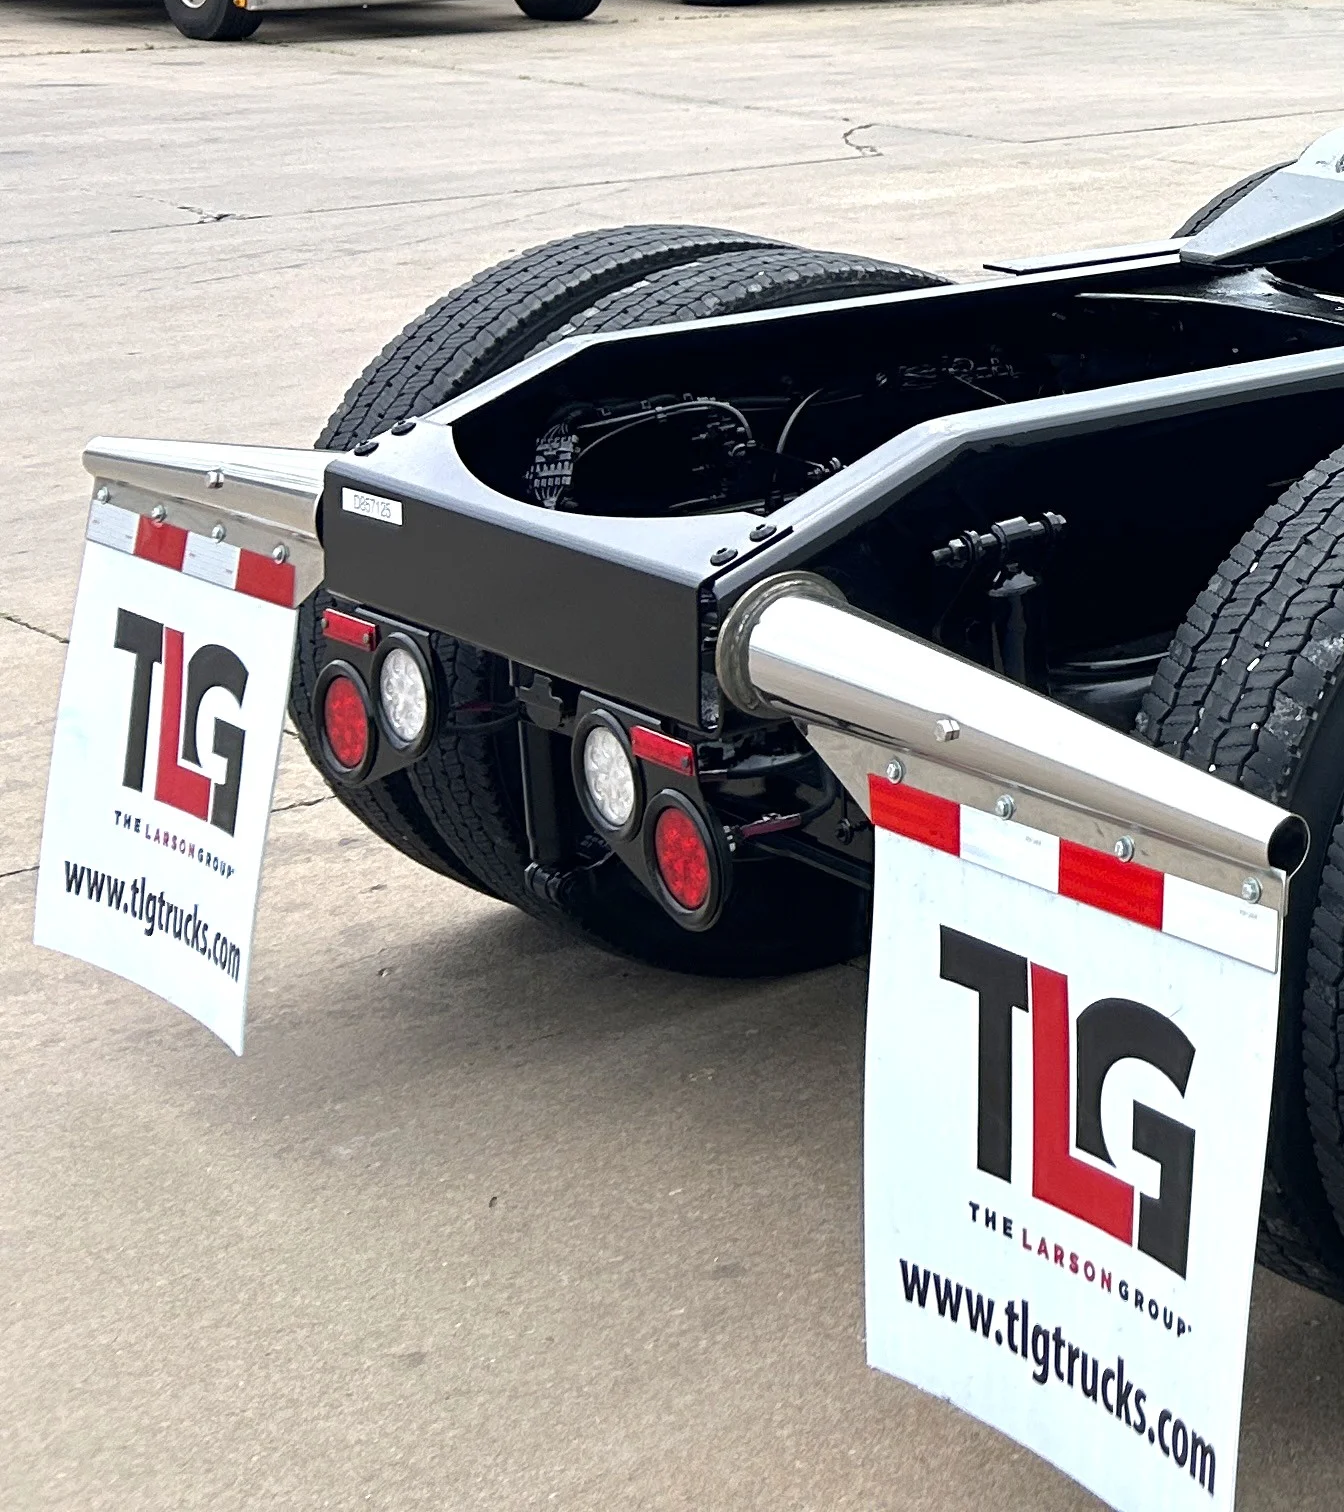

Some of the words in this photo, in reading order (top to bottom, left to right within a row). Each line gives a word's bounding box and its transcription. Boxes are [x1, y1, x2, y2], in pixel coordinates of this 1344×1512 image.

[113, 606, 249, 838] TLG
[64, 859, 241, 984] www.tlgtrucks.com
[114, 809, 142, 834] THE
[144, 823, 195, 860] LARSON
[197, 847, 233, 880] GROUP
[938, 923, 1197, 1280] TLG
[968, 1200, 1013, 1239] THE
[1021, 1227, 1112, 1294] LARSON
[1118, 1279, 1188, 1338] GROUP
[899, 1257, 1215, 1497] www.tlgtrucks.com
